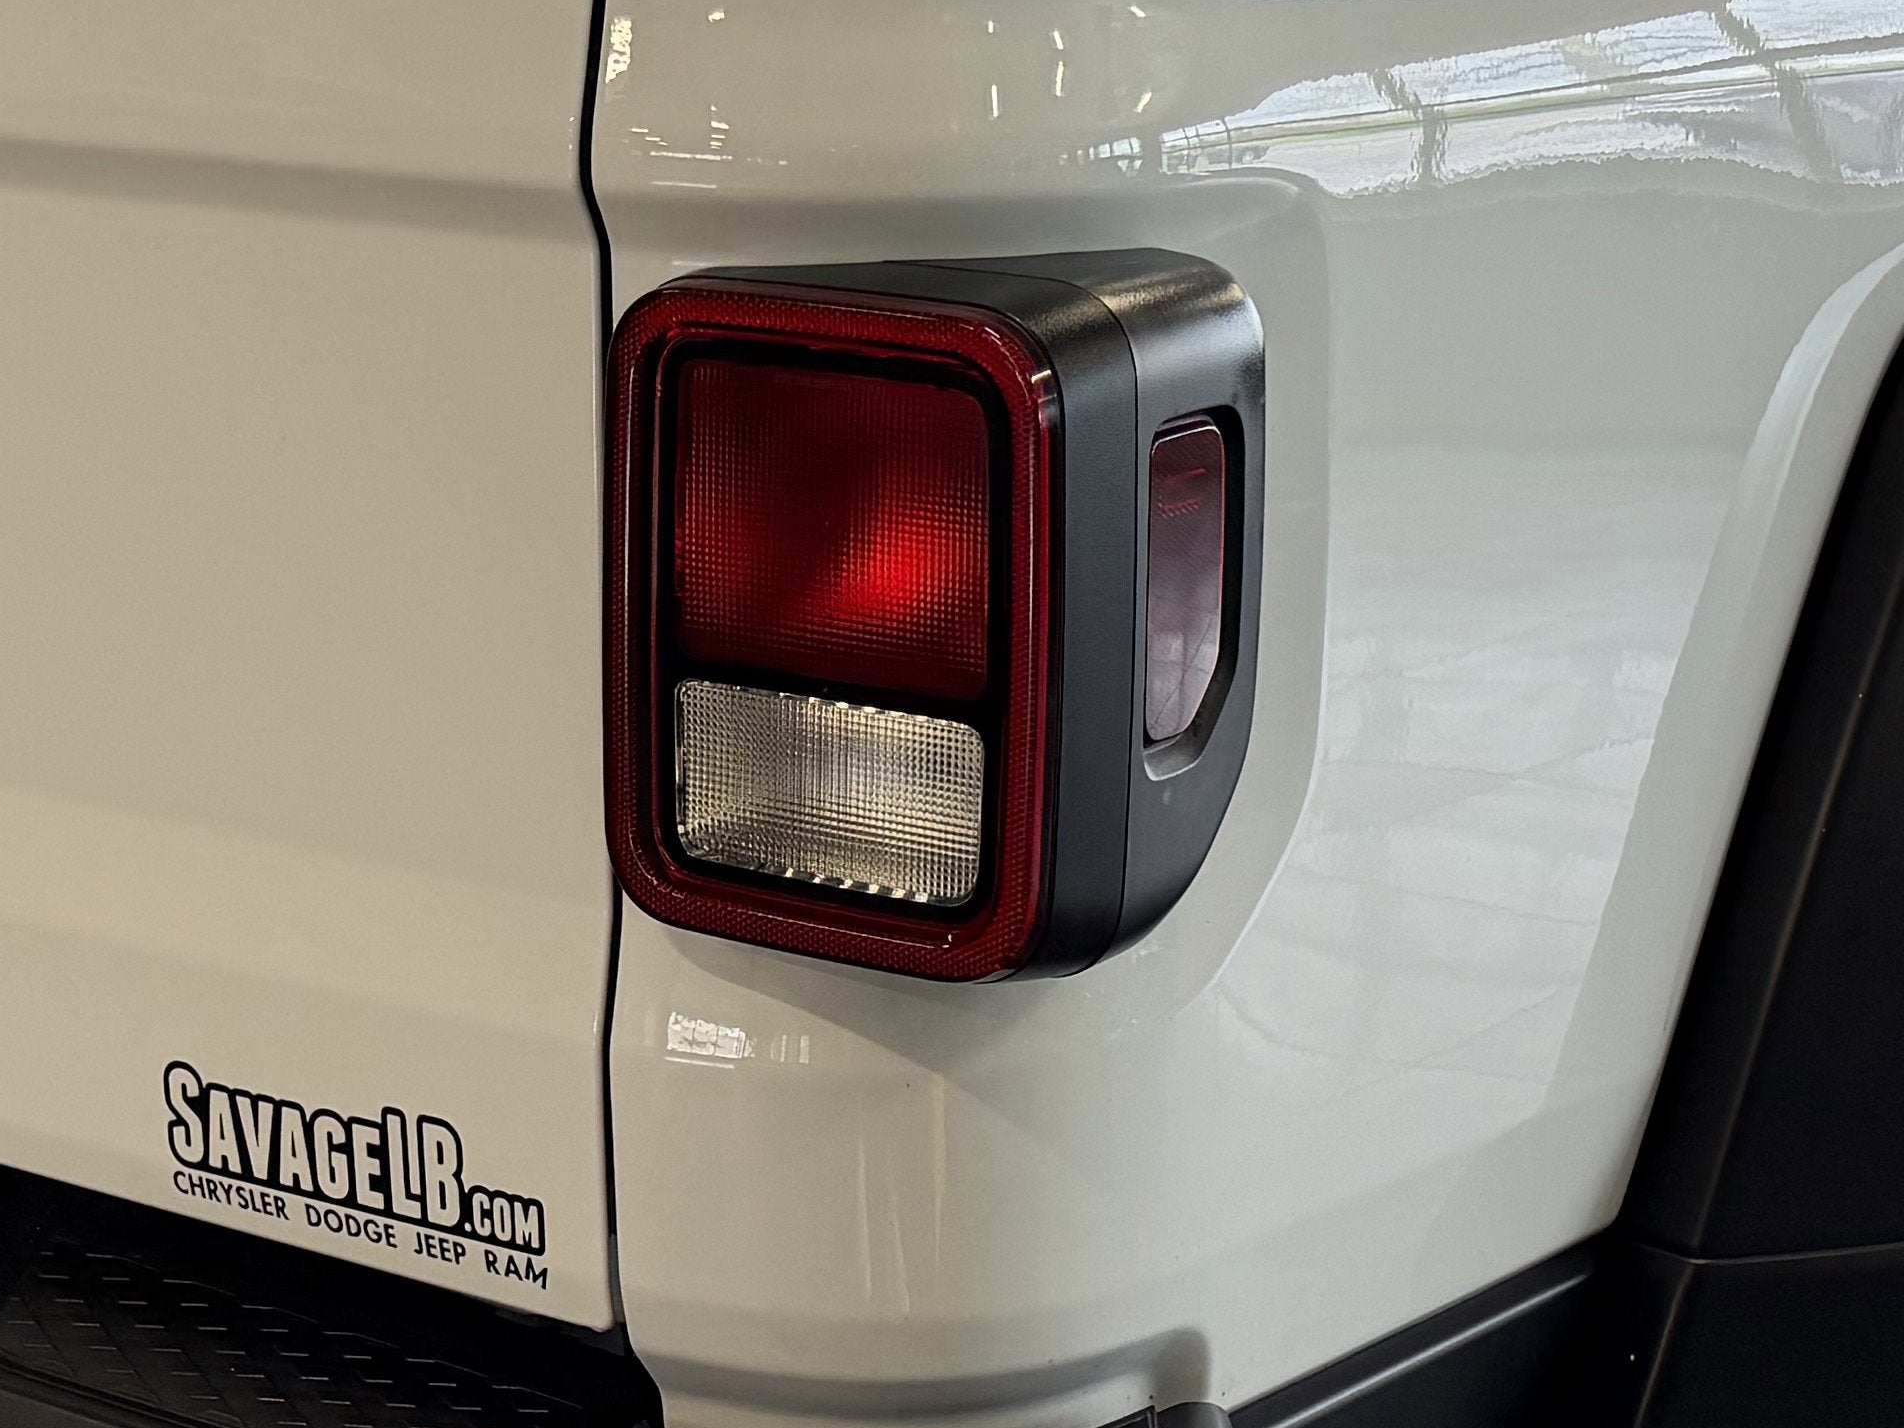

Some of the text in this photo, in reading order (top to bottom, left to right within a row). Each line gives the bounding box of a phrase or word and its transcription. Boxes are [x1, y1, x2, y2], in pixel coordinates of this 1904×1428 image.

[173, 1170, 549, 1291] CHRYSLER DODGE JEEP RAM
